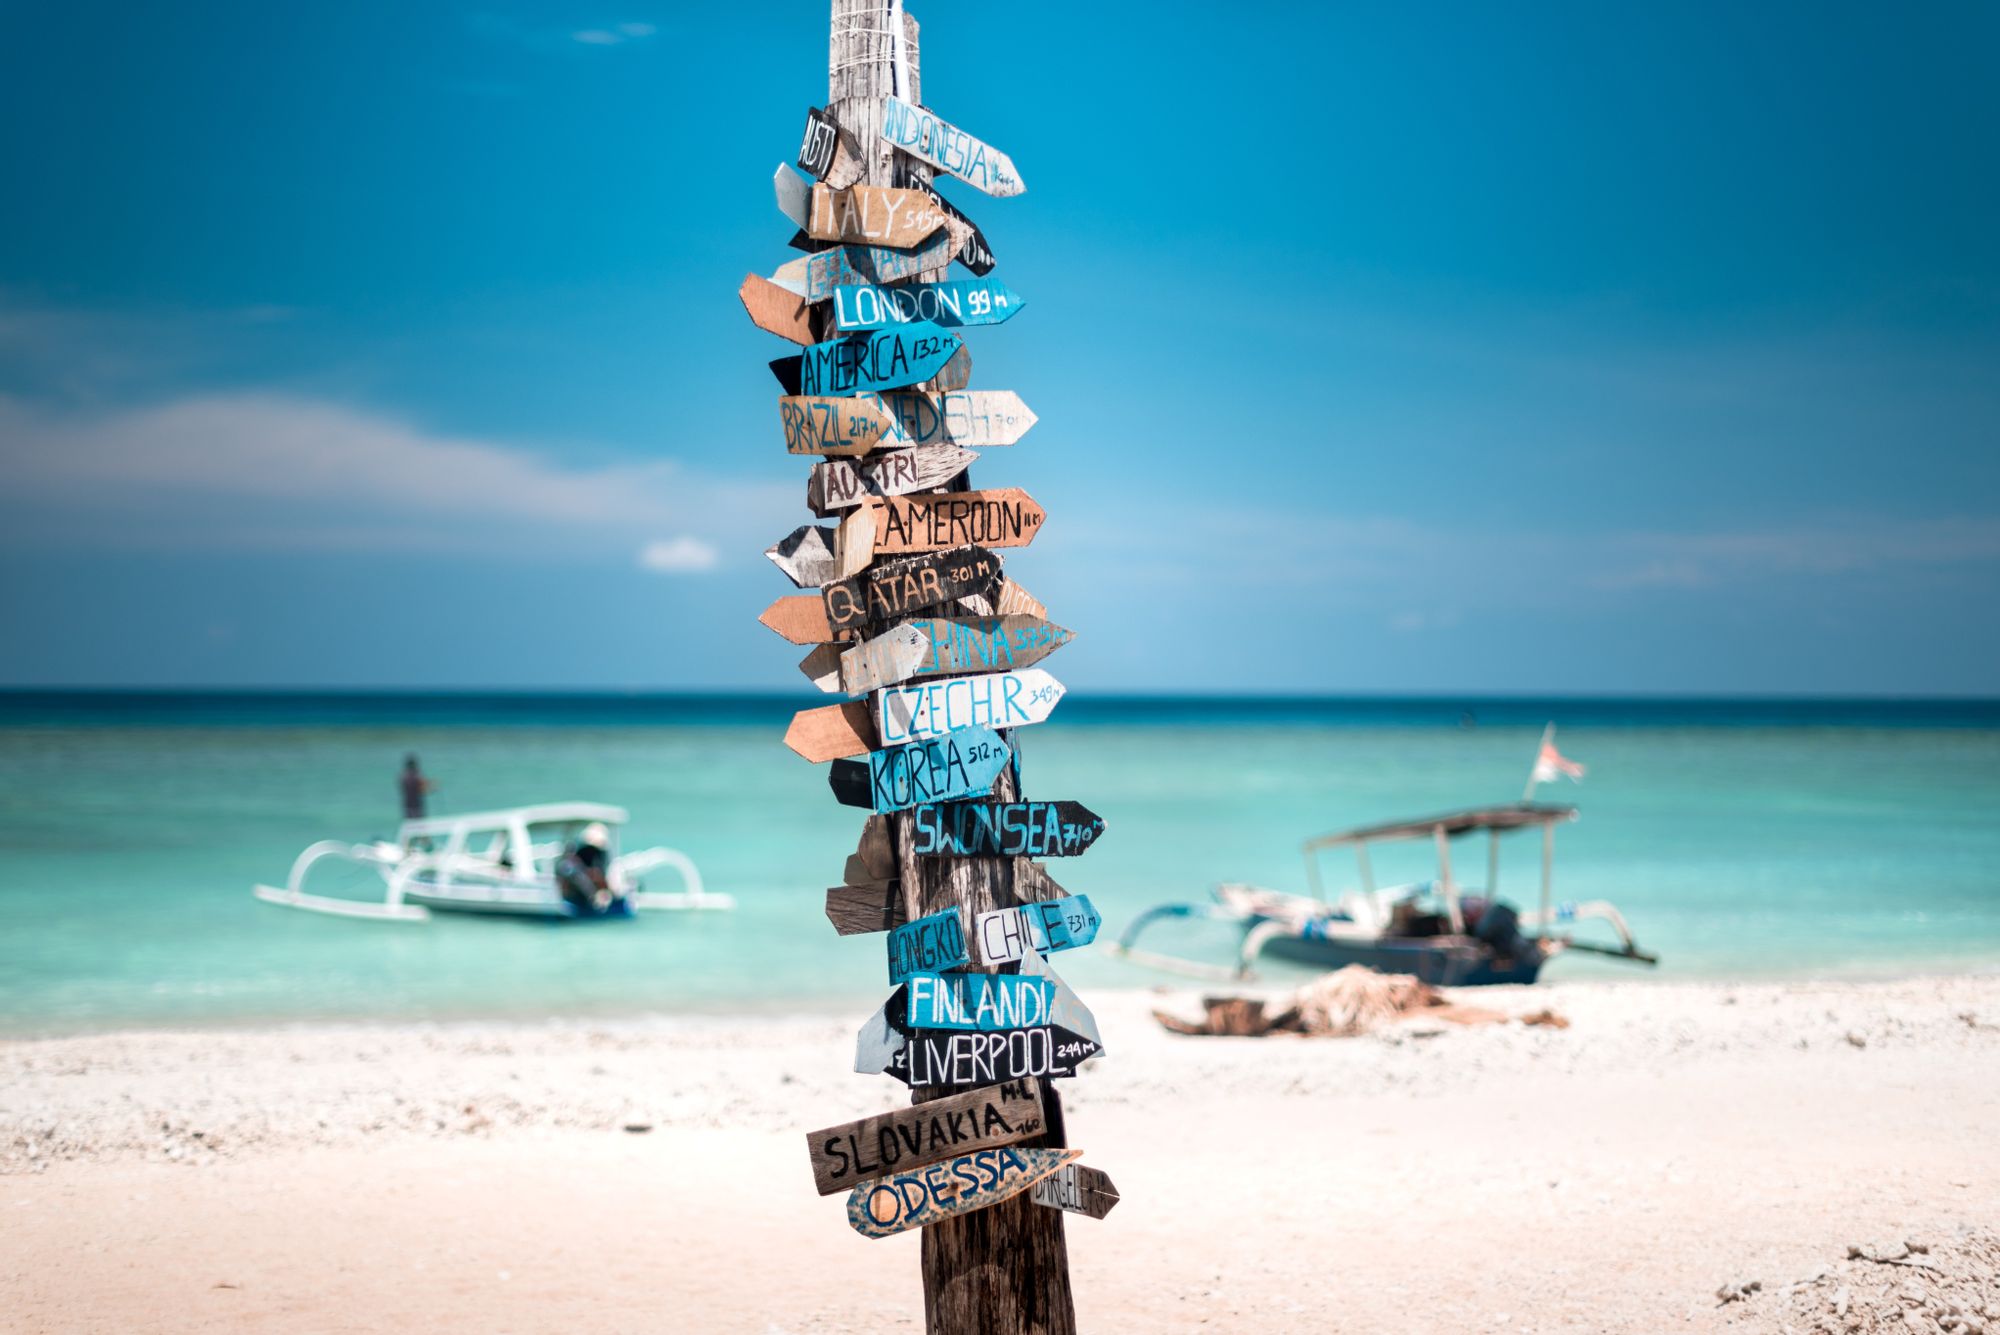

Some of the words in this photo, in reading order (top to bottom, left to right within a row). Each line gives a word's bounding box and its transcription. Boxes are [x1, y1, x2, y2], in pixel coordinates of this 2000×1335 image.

[884, 96, 987, 188] INDONESIA
[812, 188, 905, 247] ITALY
[835, 287, 962, 327] LONDON
[968, 289, 991, 316] 99
[804, 334, 909, 396] AMERICA
[912, 336, 942, 361] 132
[781, 401, 853, 450] BRAZIL
[849, 416, 869, 438] 217
[827, 568, 942, 624] QATAR
[950, 565, 974, 584] 301
[1014, 625, 1051, 650] 375
[872, 739, 970, 808] KOREA
[968, 743, 990, 765] 512
[915, 802, 1064, 856] SWONSEA
[984, 904, 1067, 960] CHILE
[1066, 913, 1086, 934] 731
[909, 1028, 1068, 1086] LIVERPOOL
[824, 1103, 1014, 1178] SLOVAKIA
[866, 1147, 1026, 1227] ODESSA
